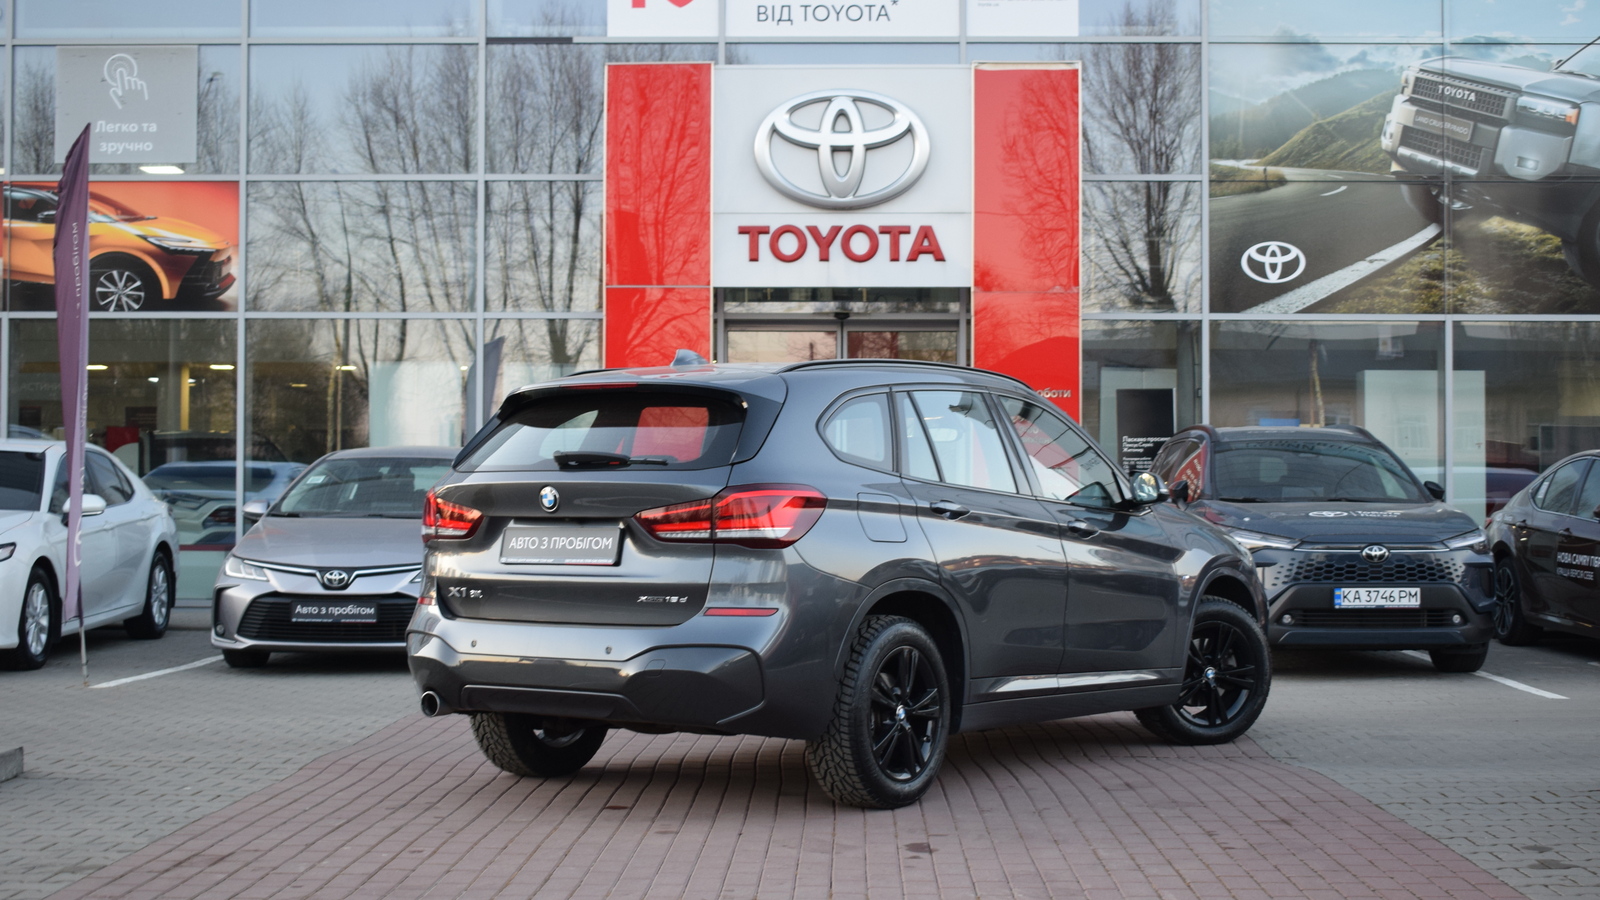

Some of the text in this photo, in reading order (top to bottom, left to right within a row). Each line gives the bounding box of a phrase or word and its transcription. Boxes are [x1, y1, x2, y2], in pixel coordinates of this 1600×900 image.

[756, 4, 794, 26] ВІД
[1438, 85, 1476, 102] TOYOTA
[95, 120, 157, 133] Легко та
[1415, 115, 1428, 125] LAND
[99, 141, 153, 155] зручно
[737, 224, 946, 263] TOYOTA
[1036, 387, 1072, 398] оботи
[508, 536, 613, 550] АВТО З ПРОБІГОМ
[447, 586, 467, 598] X1
[1342, 590, 1419, 603] KA 3746 PM
[295, 604, 375, 616] Авто з пробігом
